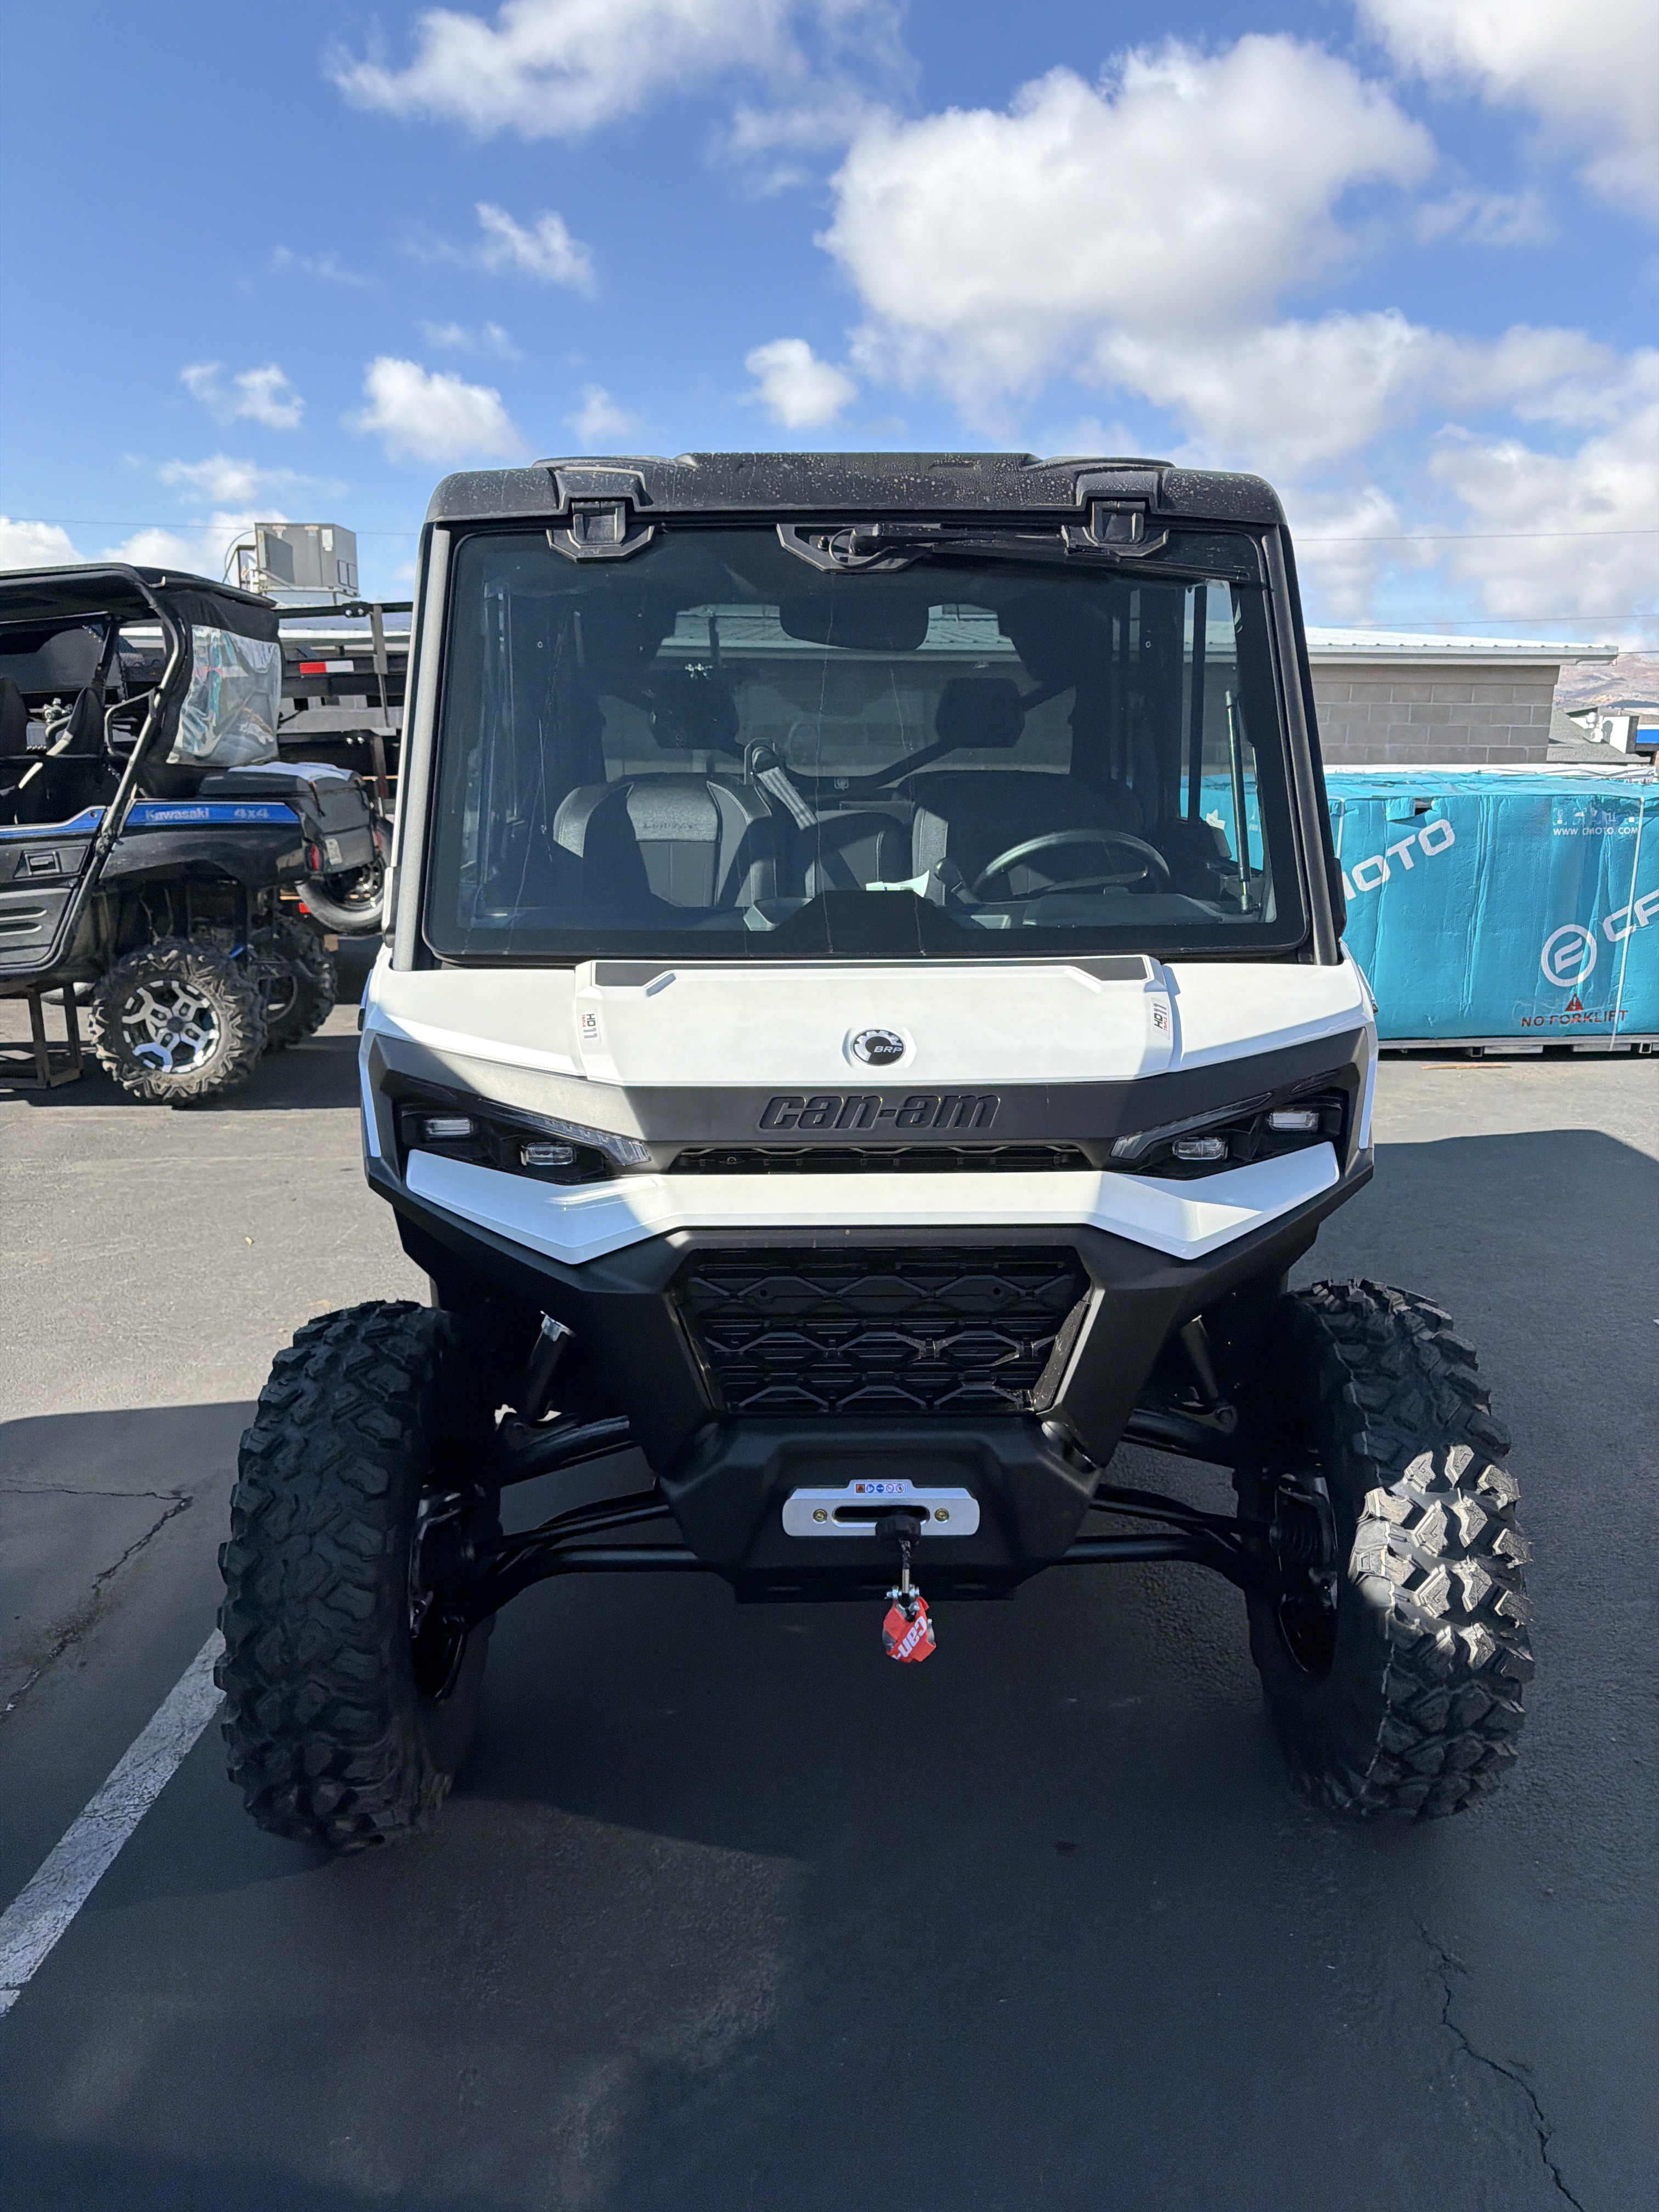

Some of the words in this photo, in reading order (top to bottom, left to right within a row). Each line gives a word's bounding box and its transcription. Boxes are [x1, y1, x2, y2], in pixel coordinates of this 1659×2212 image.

[145, 808, 209, 821] Kawasaki
[234, 808, 269, 819] 4x4
[1521, 1016, 1545, 1027] NO
[1549, 1010, 1628, 1025] FORKLIFT
